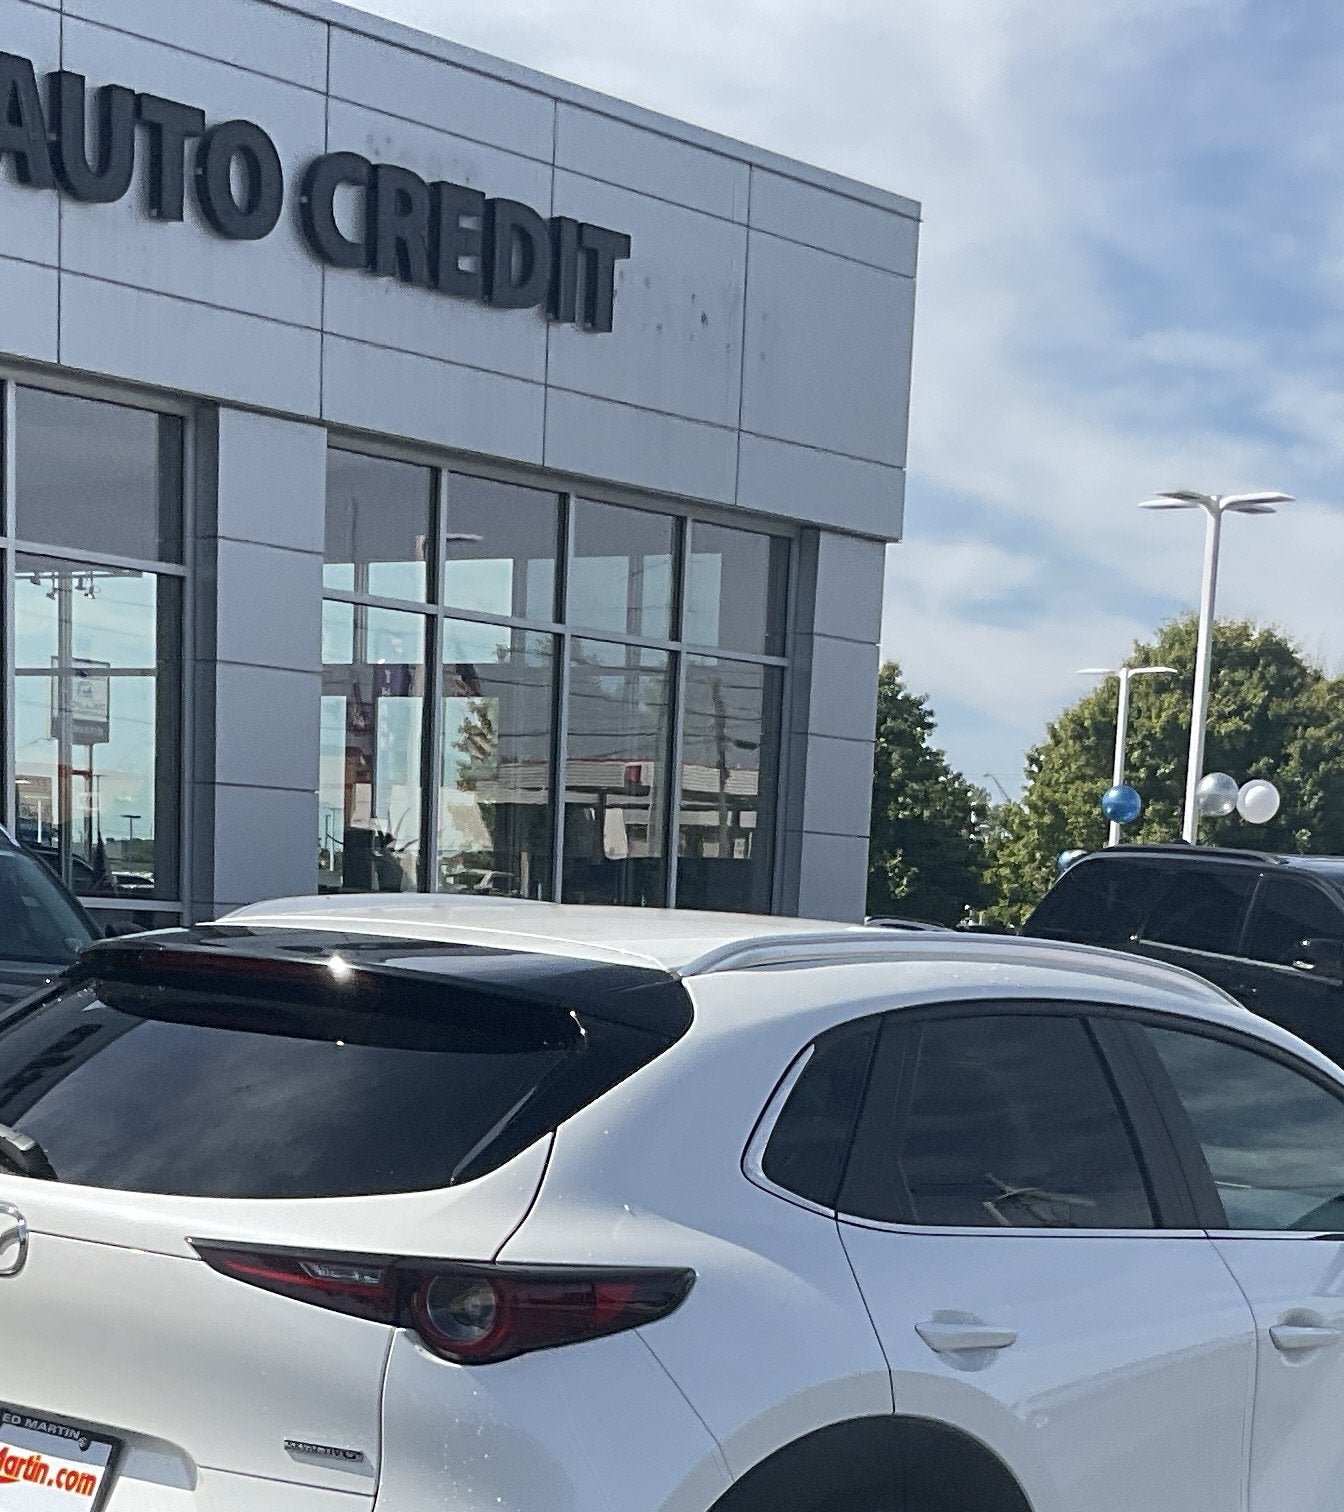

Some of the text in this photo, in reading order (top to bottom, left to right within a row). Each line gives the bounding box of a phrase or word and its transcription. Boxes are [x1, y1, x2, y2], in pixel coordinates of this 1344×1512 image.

[297, 150, 632, 333] CREDIT
[2, 1412, 81, 1440] ED MARTIN
